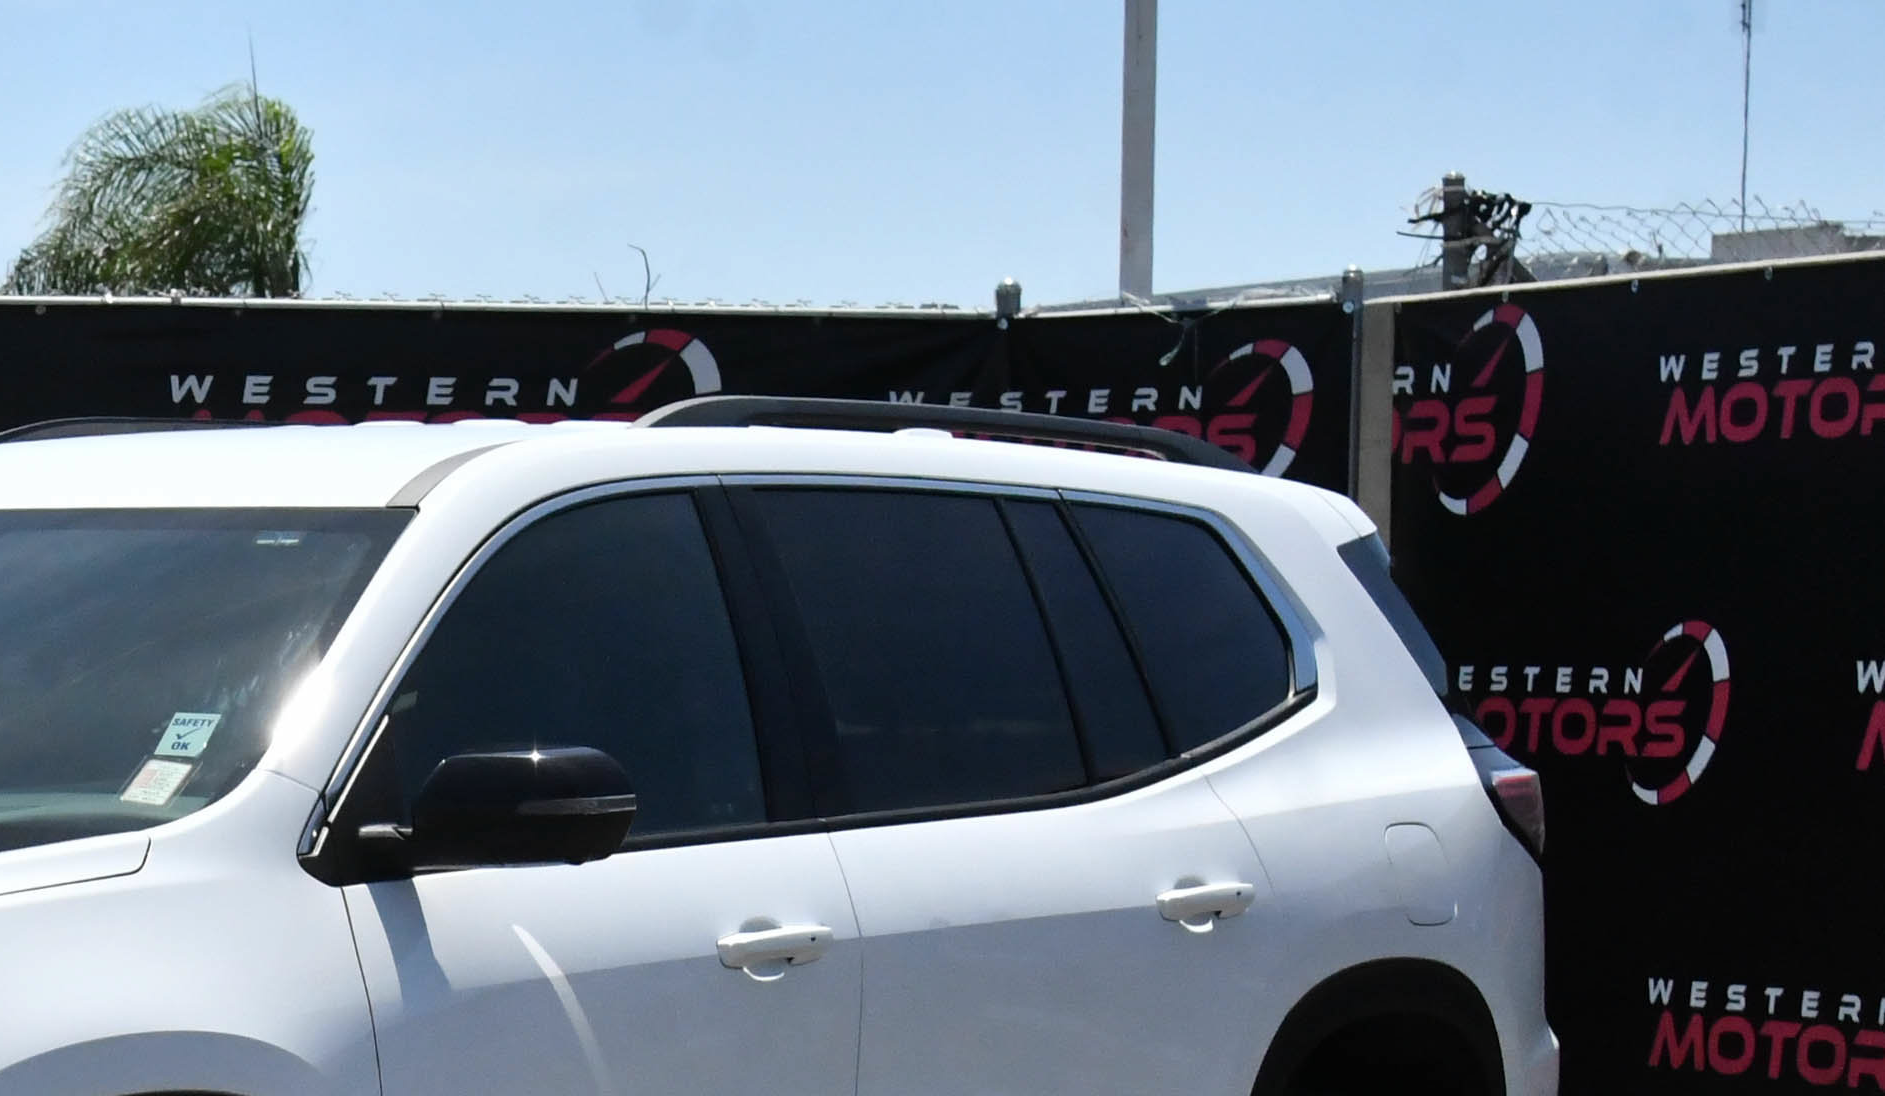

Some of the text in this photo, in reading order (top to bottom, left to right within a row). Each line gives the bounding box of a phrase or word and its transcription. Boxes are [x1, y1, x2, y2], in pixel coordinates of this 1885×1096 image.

[170, 375, 578, 407] WESTERN
[172, 718, 214, 728] SAFETY
[171, 741, 191, 750] OK
[1648, 977, 1885, 1026] WESTER
